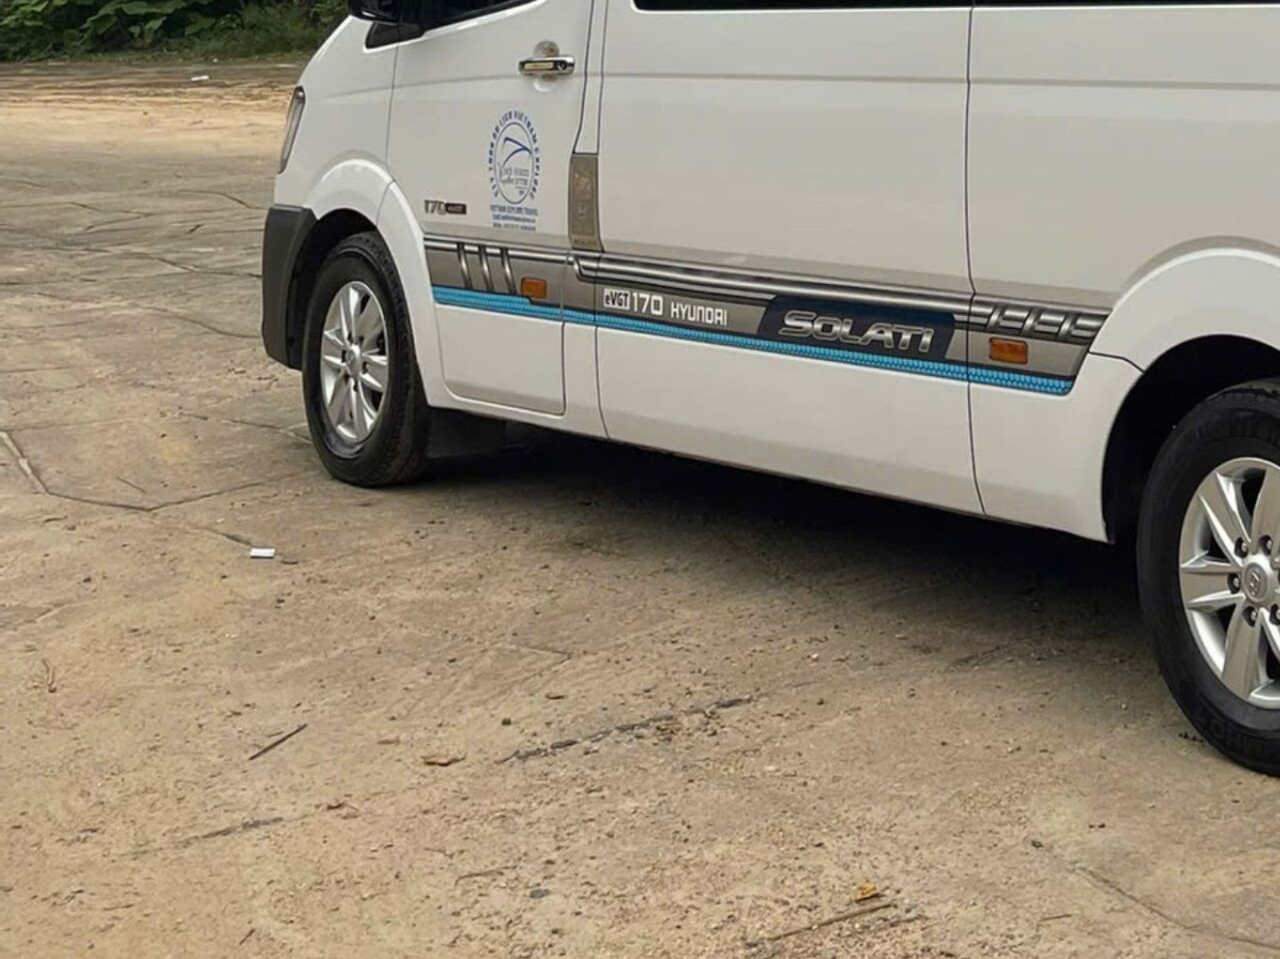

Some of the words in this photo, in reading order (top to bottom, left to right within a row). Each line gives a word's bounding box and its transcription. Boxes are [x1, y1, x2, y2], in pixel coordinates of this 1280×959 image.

[632, 292, 663, 316] 170
[670, 301, 728, 327] HYUNDAI
[778, 310, 934, 353] SOLATI
